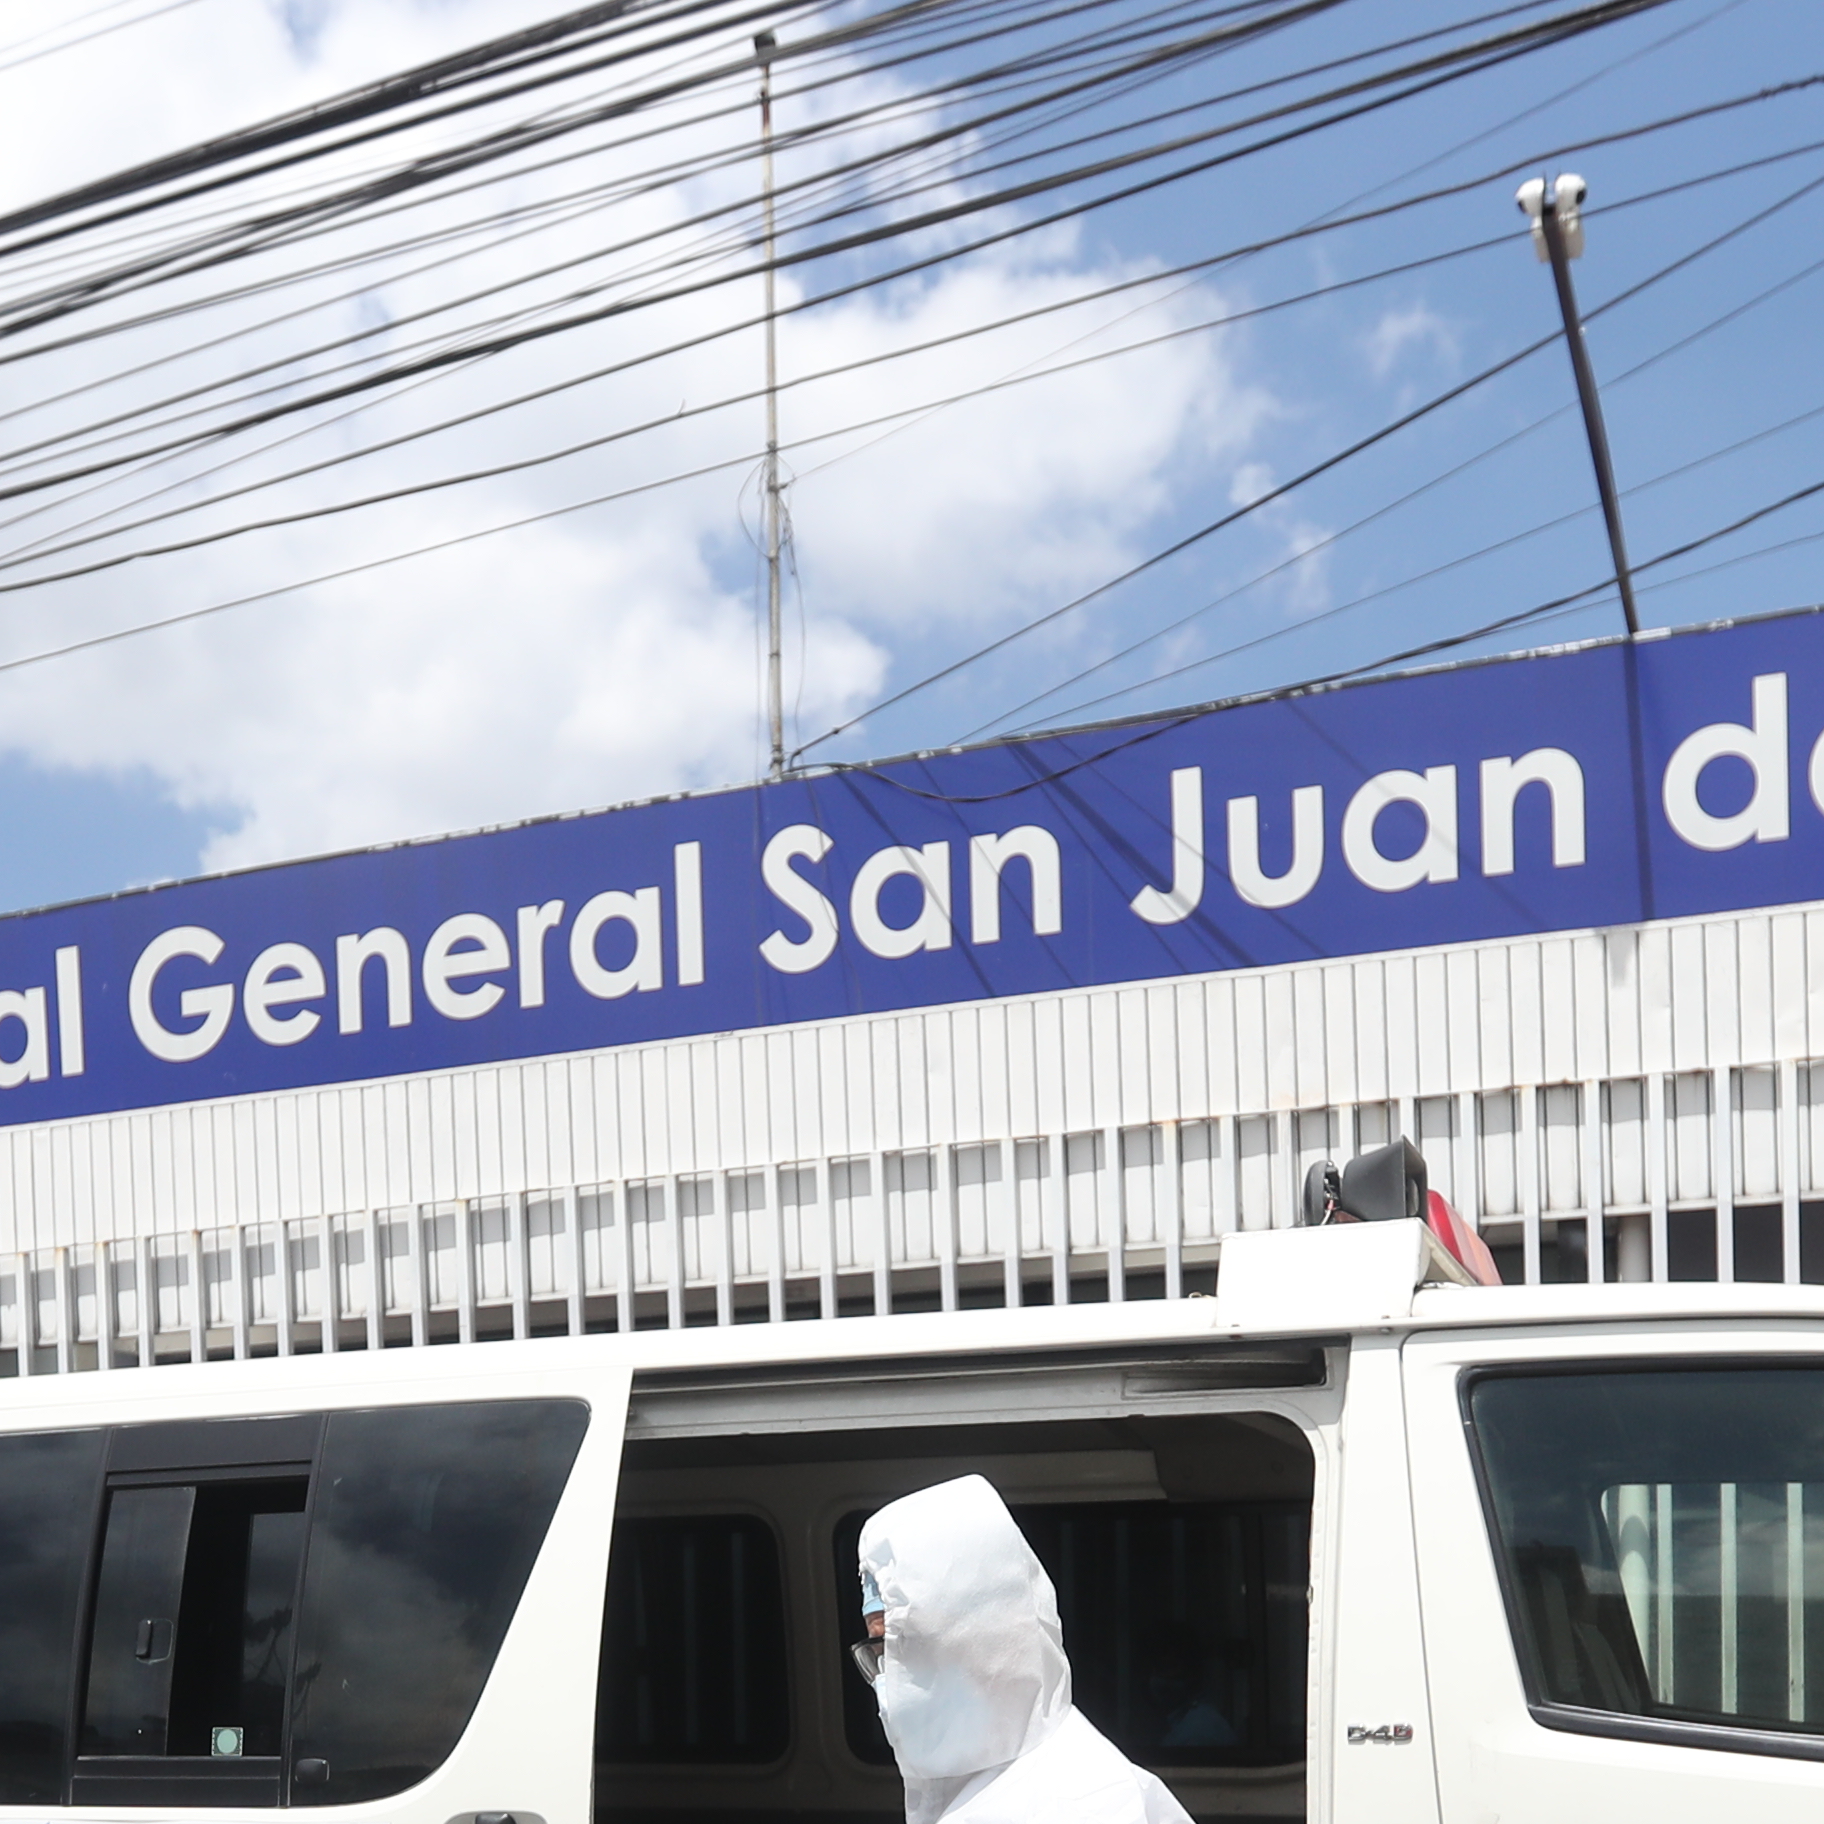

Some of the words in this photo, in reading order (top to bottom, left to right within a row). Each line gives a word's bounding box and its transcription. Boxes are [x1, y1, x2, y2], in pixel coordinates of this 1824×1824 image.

[128, 840, 705, 1063] General
[758, 823, 1063, 974] San
[1129, 746, 1586, 925] Juan
